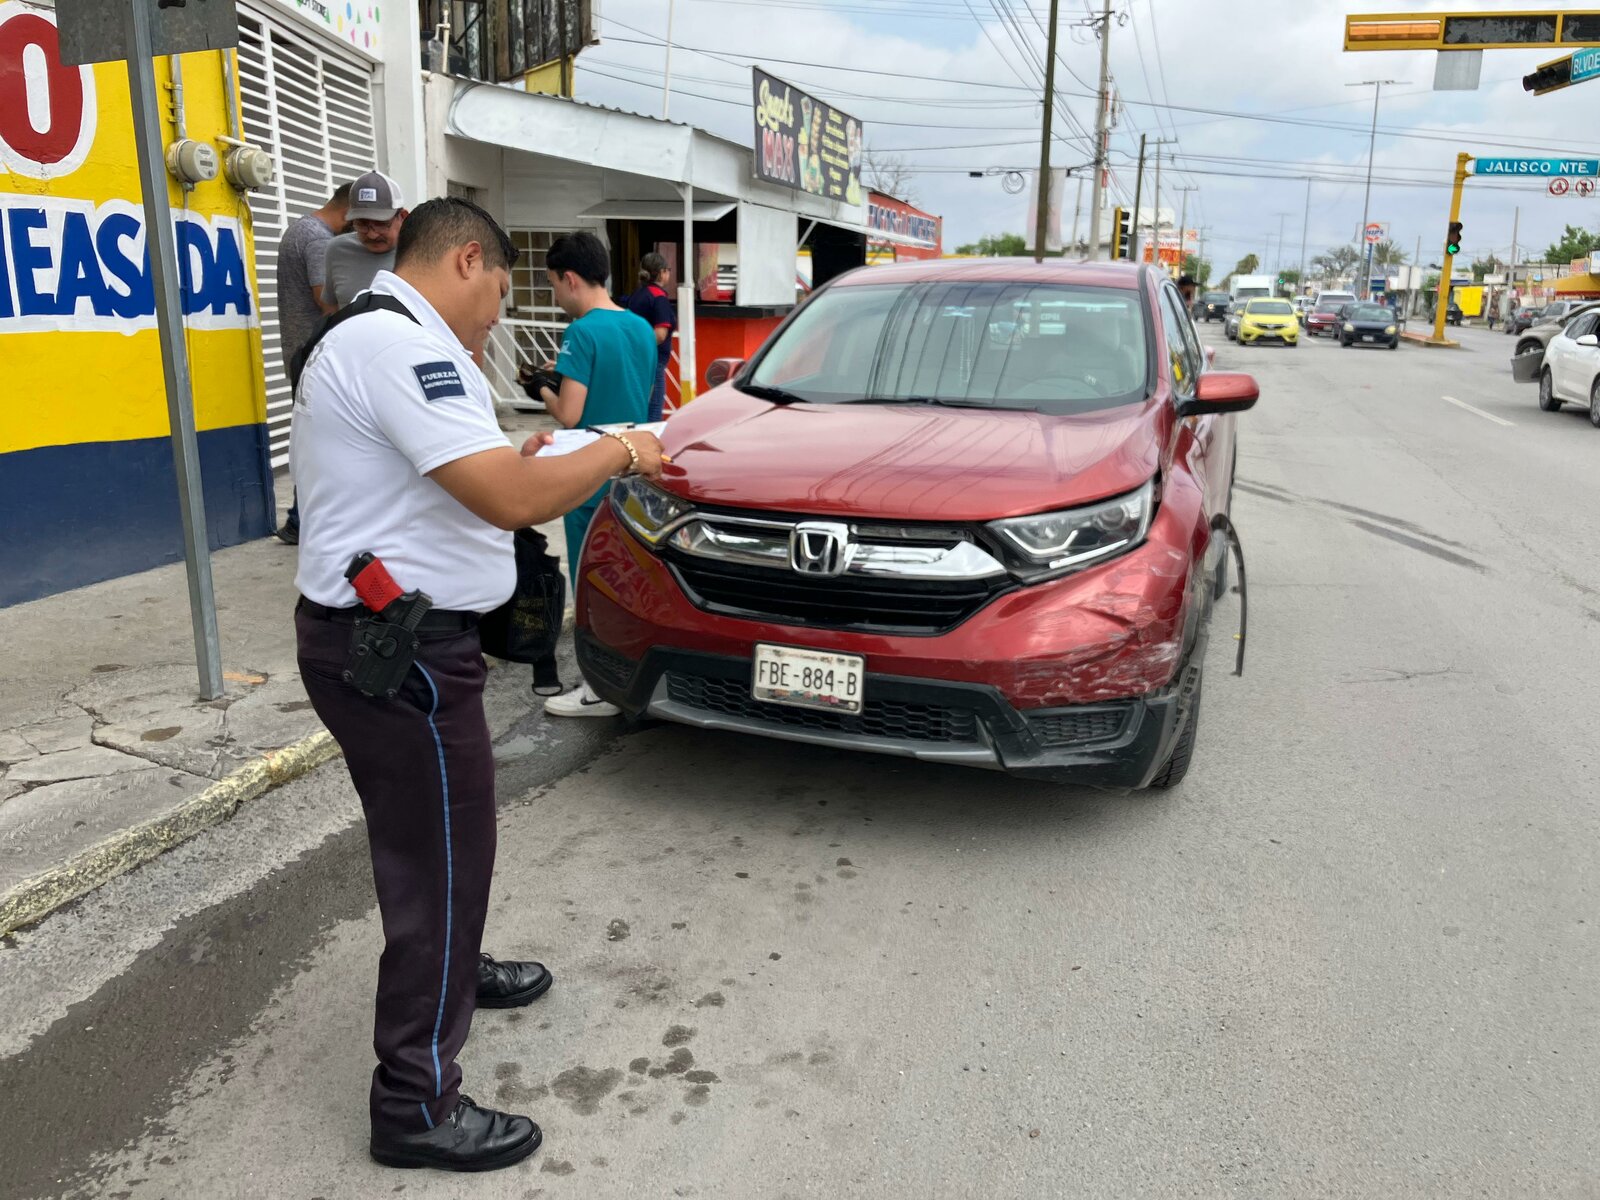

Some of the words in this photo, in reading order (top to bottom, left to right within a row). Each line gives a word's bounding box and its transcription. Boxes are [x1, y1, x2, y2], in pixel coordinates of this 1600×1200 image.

[762, 126, 796, 184] MAX
[1485, 161, 1551, 173] JALISCO
[421, 370, 458, 382] FUERZAS
[758, 659, 858, 696] FBE-884-B
